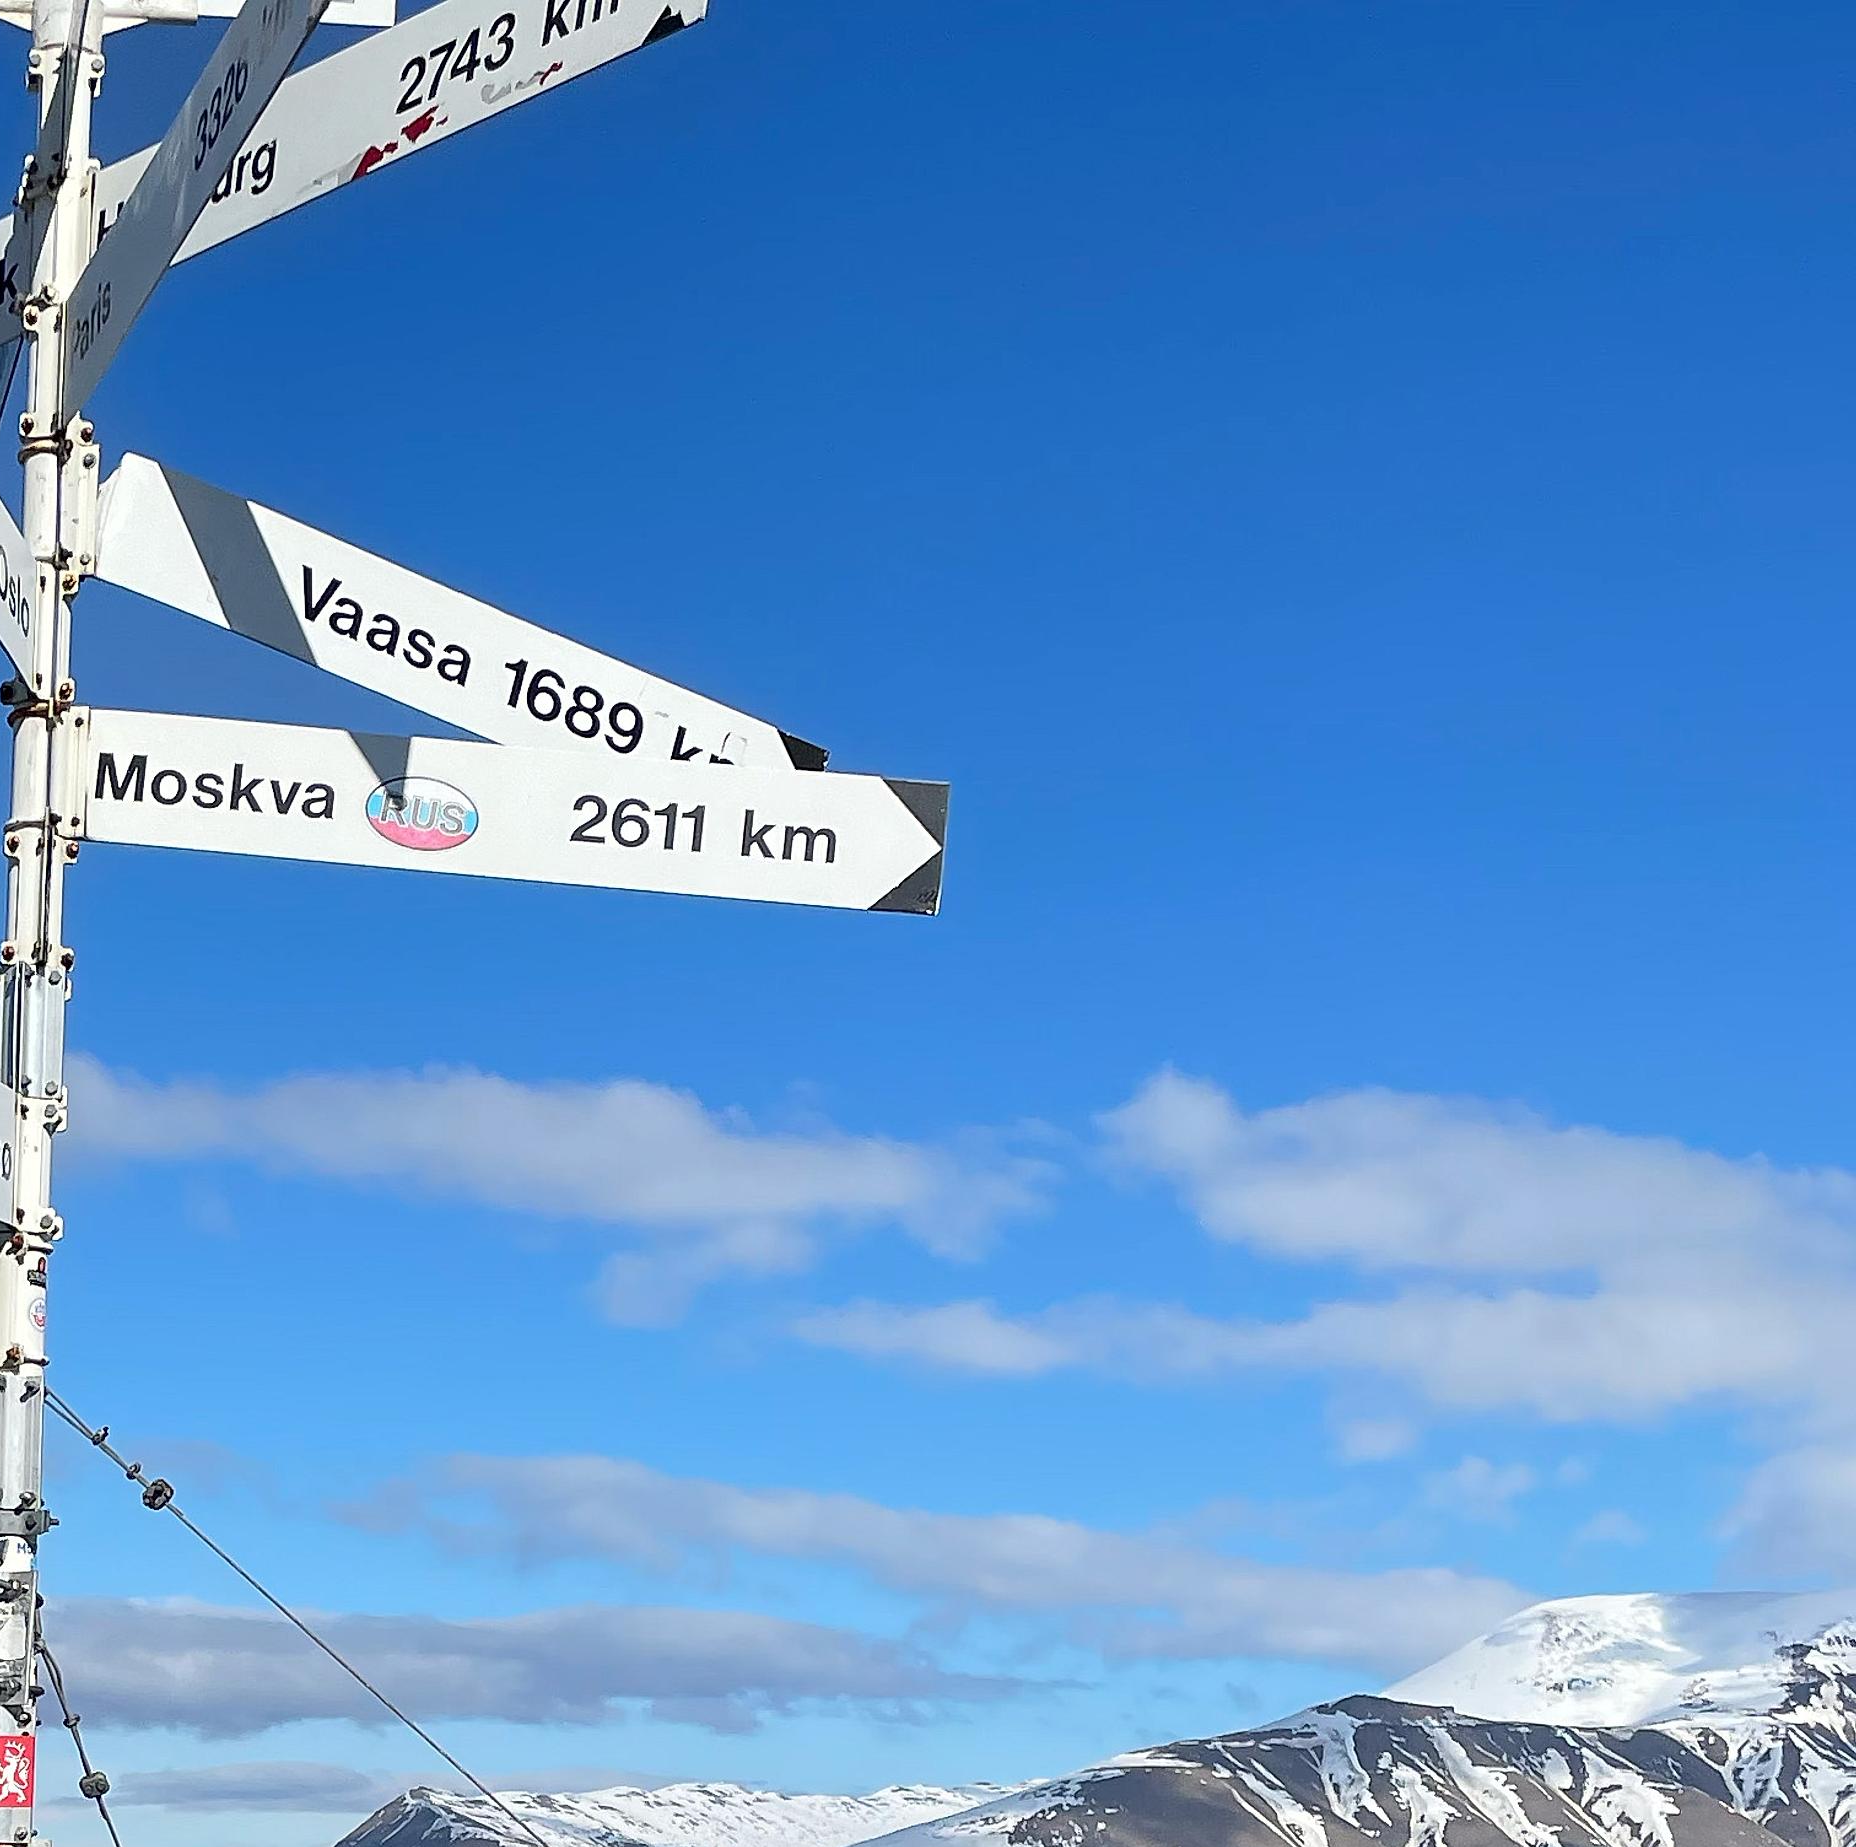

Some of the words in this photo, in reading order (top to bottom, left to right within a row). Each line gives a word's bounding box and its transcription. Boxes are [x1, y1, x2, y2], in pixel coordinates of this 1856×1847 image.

[395, 13, 515, 115] 2743
[194, 58, 248, 171] 3326
[300, 565, 473, 687] Vaasa
[504, 658, 644, 754] 1689
[93, 752, 335, 821] Moskva
[380, 792, 465, 836] RUS
[569, 794, 704, 853] 2611
[741, 808, 839, 865] km
